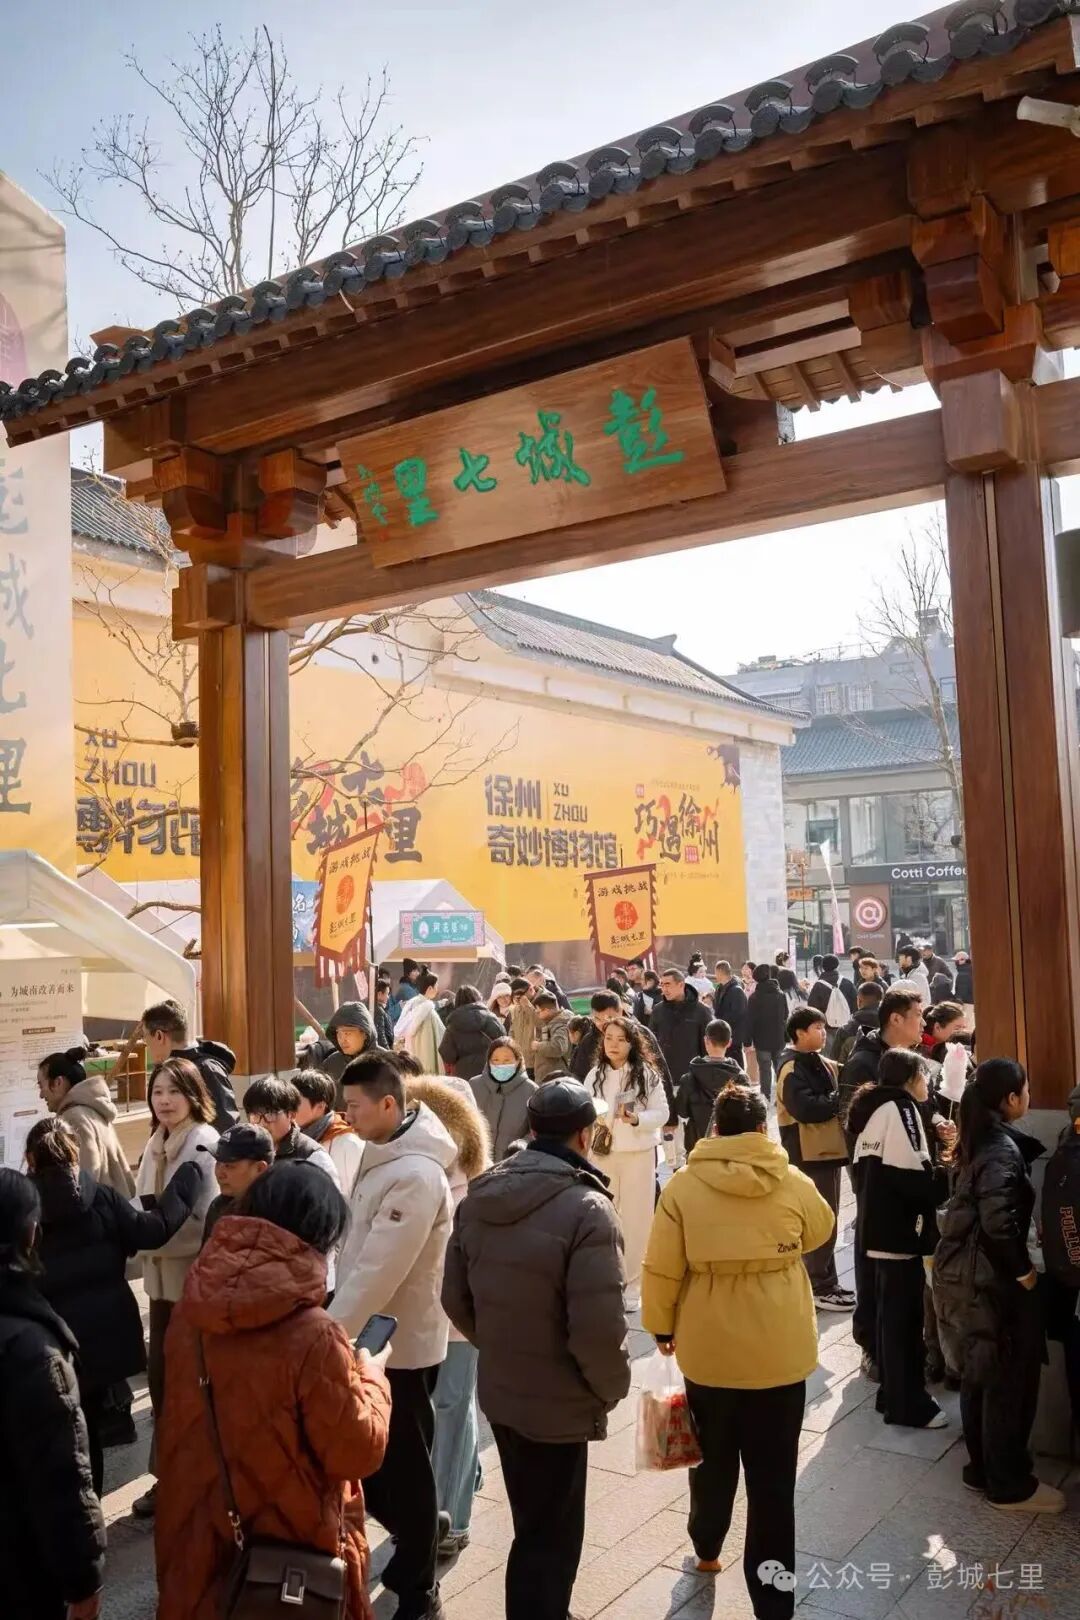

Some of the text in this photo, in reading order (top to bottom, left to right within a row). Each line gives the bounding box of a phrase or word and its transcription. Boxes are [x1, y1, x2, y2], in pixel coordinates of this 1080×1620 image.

[84, 757, 157, 788] ZHOU
[485, 774, 542, 819] 徐州
[553, 783, 569, 797] XU
[553, 803, 588, 823] ZHOU
[487, 824, 618, 869] 奇妙博物馆
[891, 866, 923, 879] Cotti
[598, 881, 648, 897] 游戏挑战
